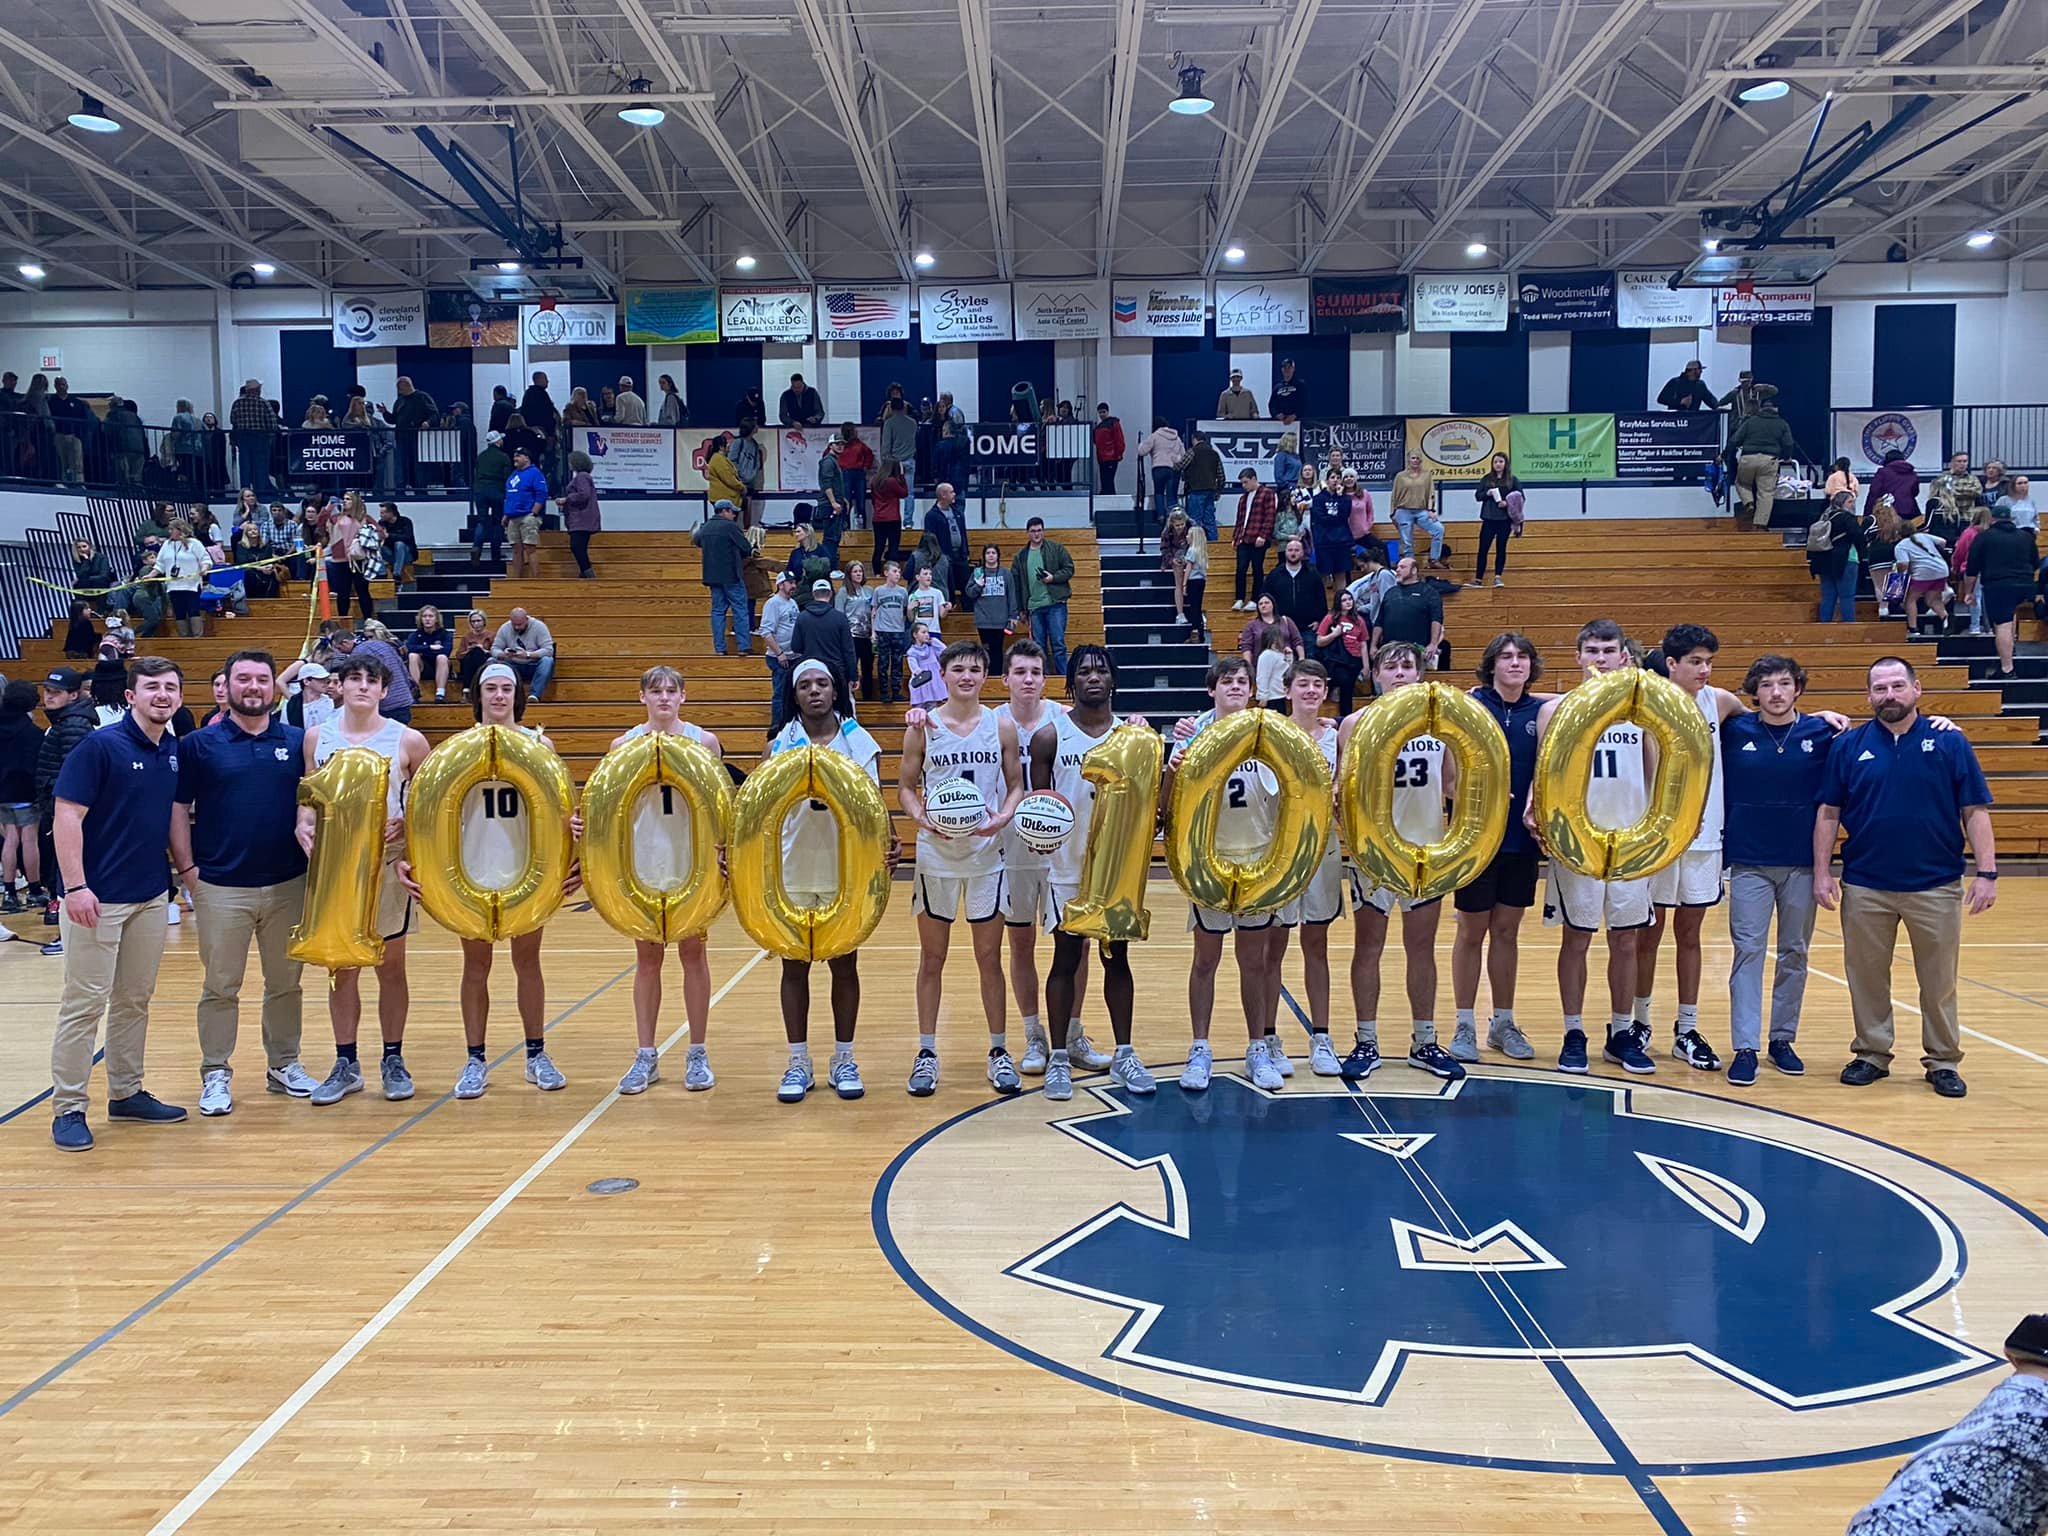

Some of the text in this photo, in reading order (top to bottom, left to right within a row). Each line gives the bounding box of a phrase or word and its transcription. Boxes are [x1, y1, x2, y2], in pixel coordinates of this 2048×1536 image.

[1623, 273, 1657, 284] CARL
[1427, 284, 1496, 295] JACKY JONES
[1541, 286, 1611, 299] WoodmenLife
[933, 288, 990, 313] Styles
[1221, 284, 1283, 316] Center
[378, 305, 420, 315] cleveland
[378, 315, 414, 325] worship
[726, 316, 809, 326] LEADING EDGE
[936, 308, 993, 331] Smiles
[1066, 317, 1087, 325] Center
[1146, 312, 1180, 326] xpress
[1181, 311, 1203, 323] lube
[1220, 310, 1305, 326] BAPTIST
[1656, 315, 1693, 323] 865-1829
[378, 323, 407, 332] center
[537, 320, 607, 337] CLAYTON
[825, 330, 904, 340] 706-865-0887
[1341, 422, 1359, 430] THE
[1676, 419, 1689, 427] LLC
[312, 435, 345, 445] HOME
[1549, 418, 1576, 450] H
[302, 448, 356, 458] STUDENT
[1352, 451, 1388, 460] Kimbrell
[305, 461, 354, 471] SECTION
[1531, 461, 1553, 470] (706)
[931, 750, 998, 766] WARRIORS
[1394, 757, 1428, 788] 23
[938, 790, 979, 805] Wilson
[1227, 777, 1248, 809] 2
[482, 787, 518, 819] 10
[661, 785, 674, 816] 1
[937, 810, 983, 825] 1000 POINTS
[1021, 816, 1061, 833] Wilson
